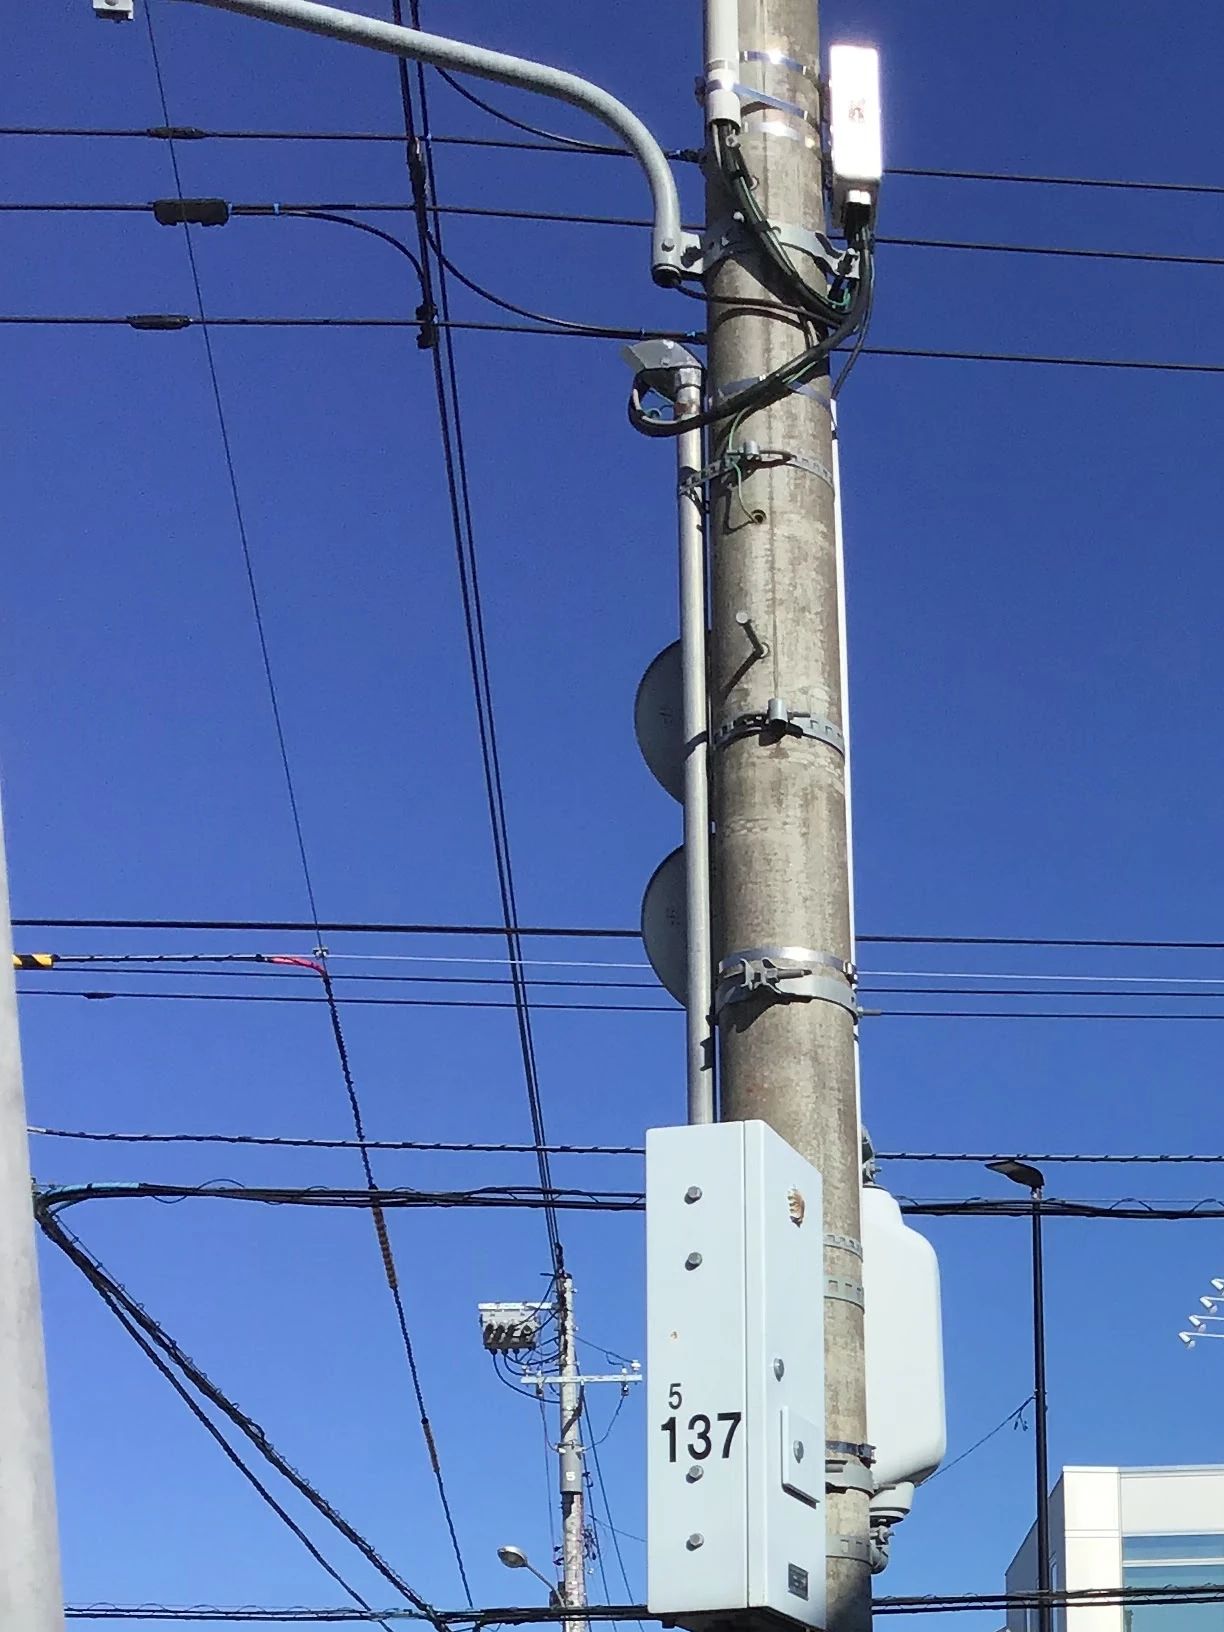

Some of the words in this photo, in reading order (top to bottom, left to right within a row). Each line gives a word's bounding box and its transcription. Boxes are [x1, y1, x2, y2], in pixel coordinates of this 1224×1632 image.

[668, 1383, 683, 1410] 5
[661, 1412, 742, 1463] 137
[566, 1472, 576, 1482] 5
